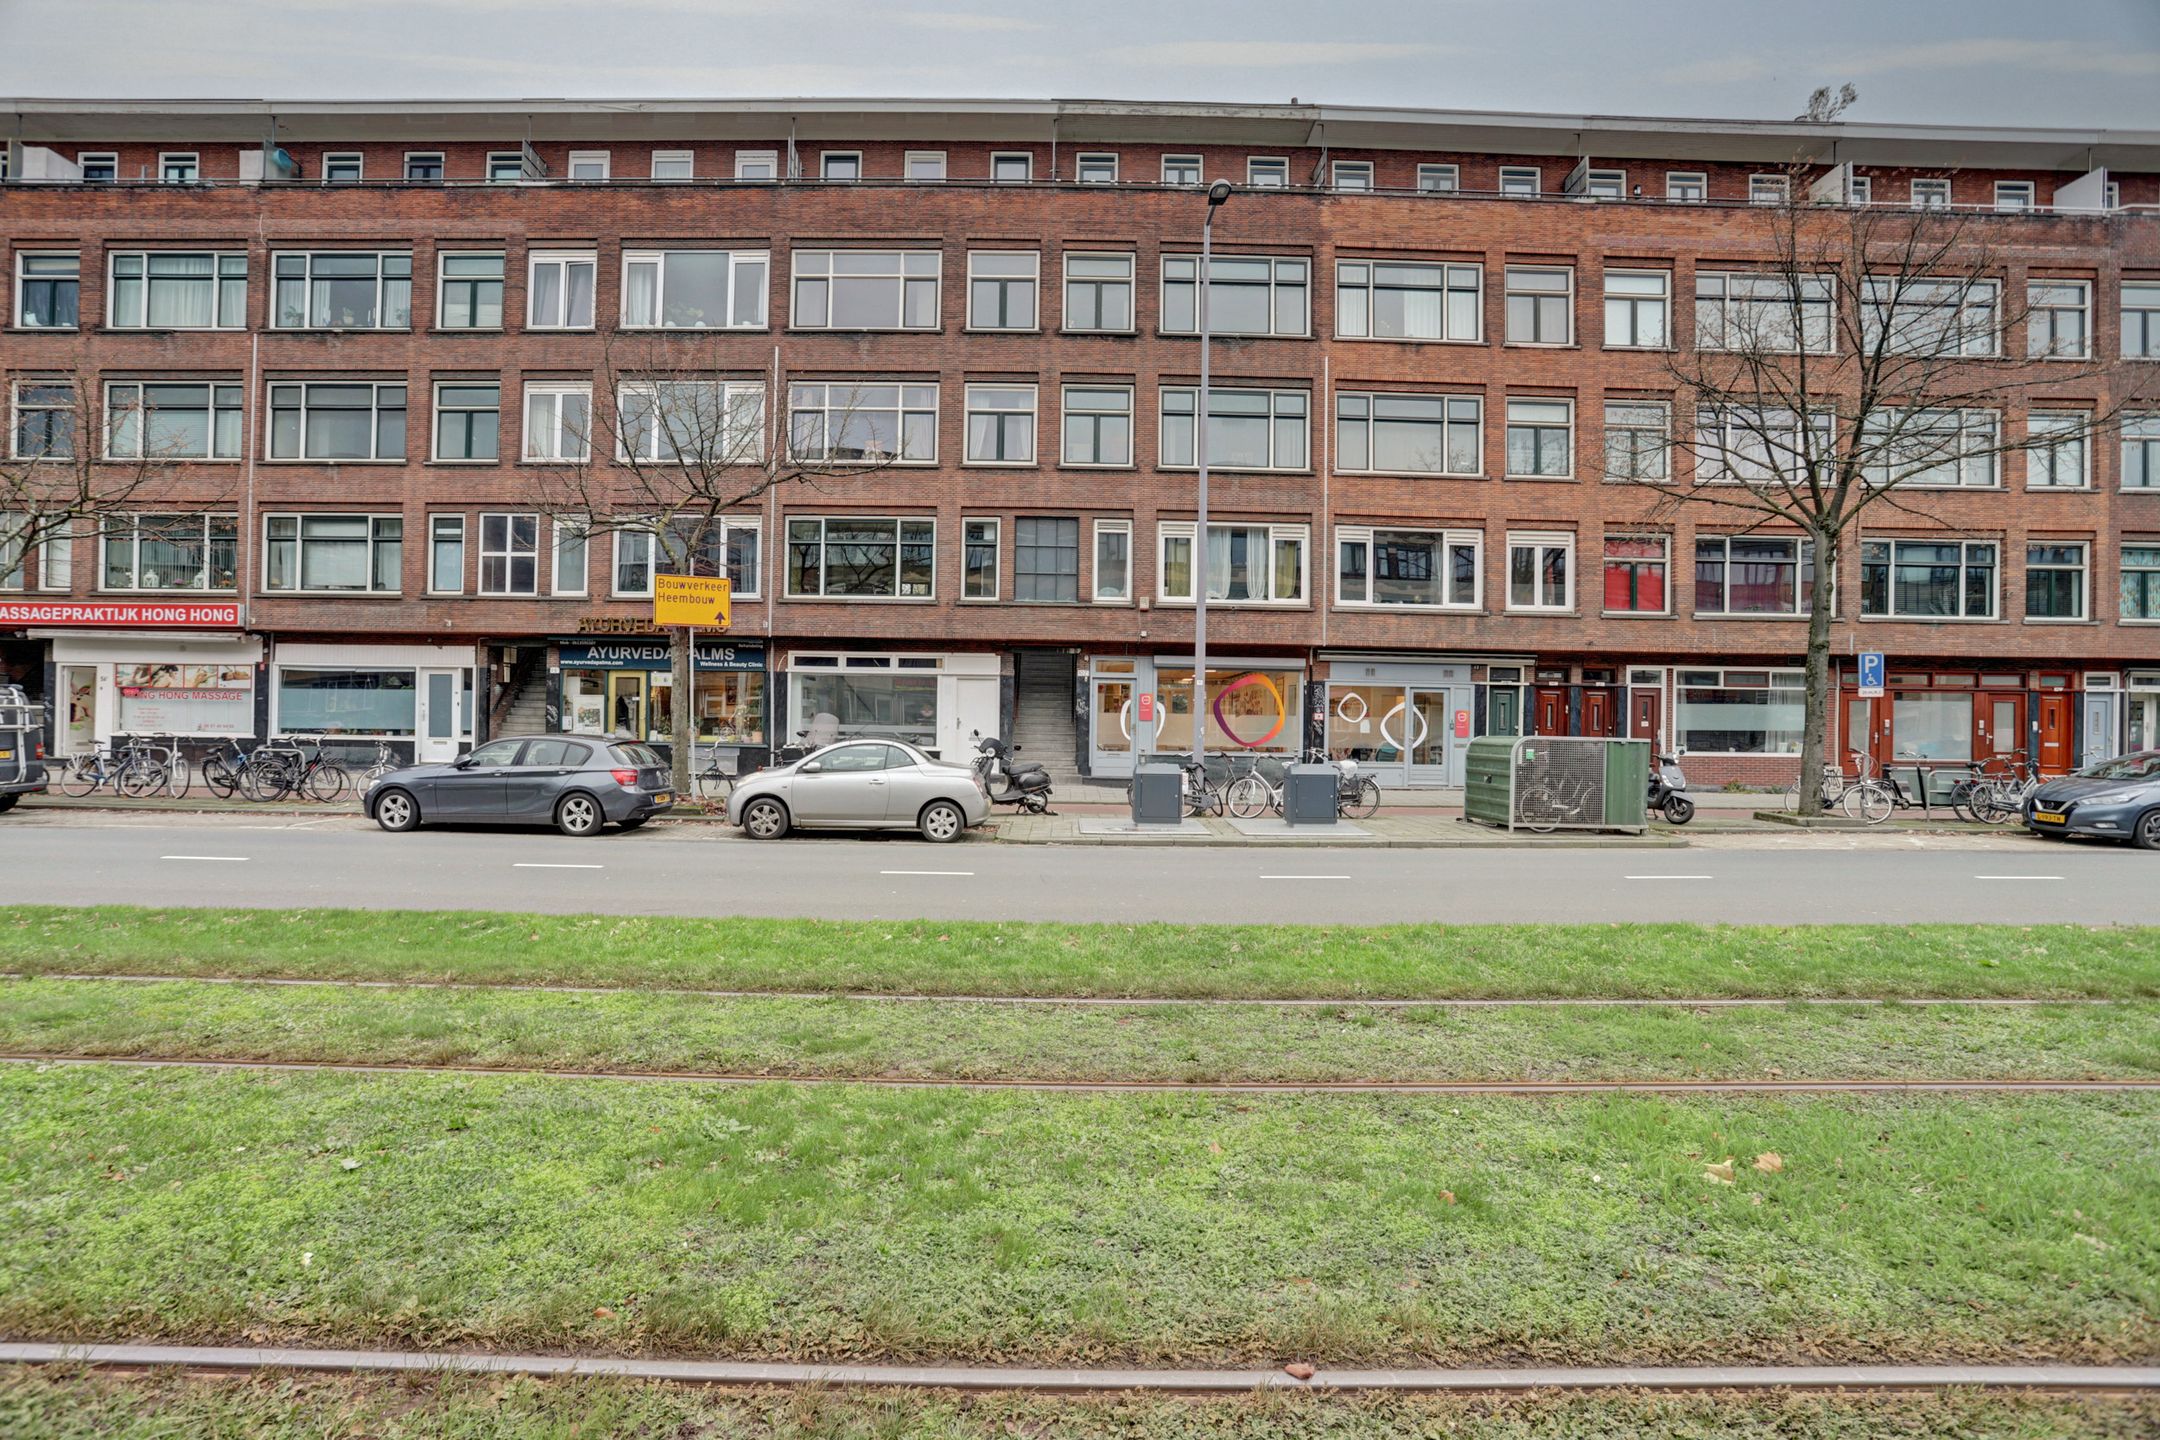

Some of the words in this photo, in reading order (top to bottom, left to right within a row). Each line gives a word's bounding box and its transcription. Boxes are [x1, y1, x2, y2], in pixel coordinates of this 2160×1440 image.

[658, 578, 728, 592] Bouwverkeer
[658, 592, 715, 604] Heembouw
[141, 608, 187, 621] HONG
[190, 608, 235, 622] HONG
[687, 647, 735, 661] ALMS
[1865, 655, 1878, 673] P
[158, 691, 189, 700] HONG
[192, 691, 243, 701] MASSAGE
